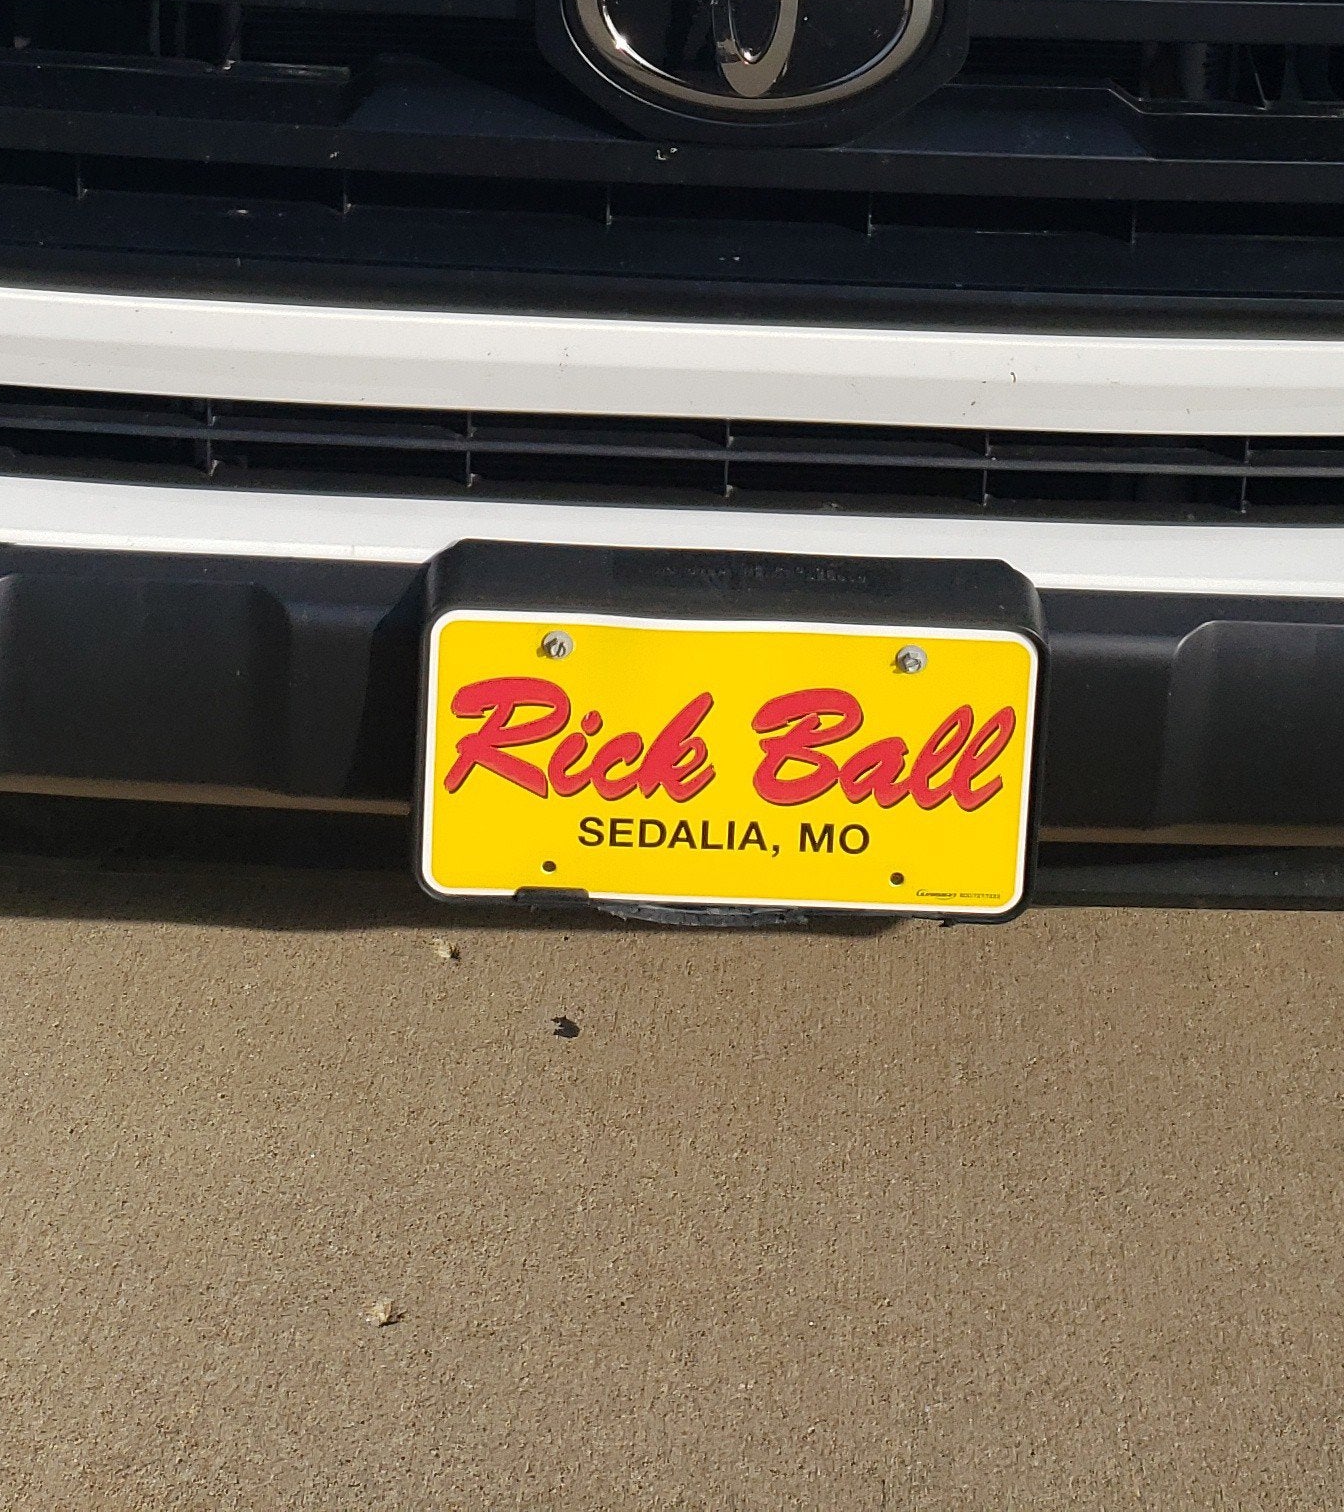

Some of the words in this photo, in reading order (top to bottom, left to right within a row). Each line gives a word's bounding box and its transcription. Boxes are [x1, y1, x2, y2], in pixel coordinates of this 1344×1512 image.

[444, 676, 716, 803] Rick
[751, 687, 1017, 813] Ball
[578, 816, 780, 858] SEDALIA,
[800, 822, 870, 855] MO
